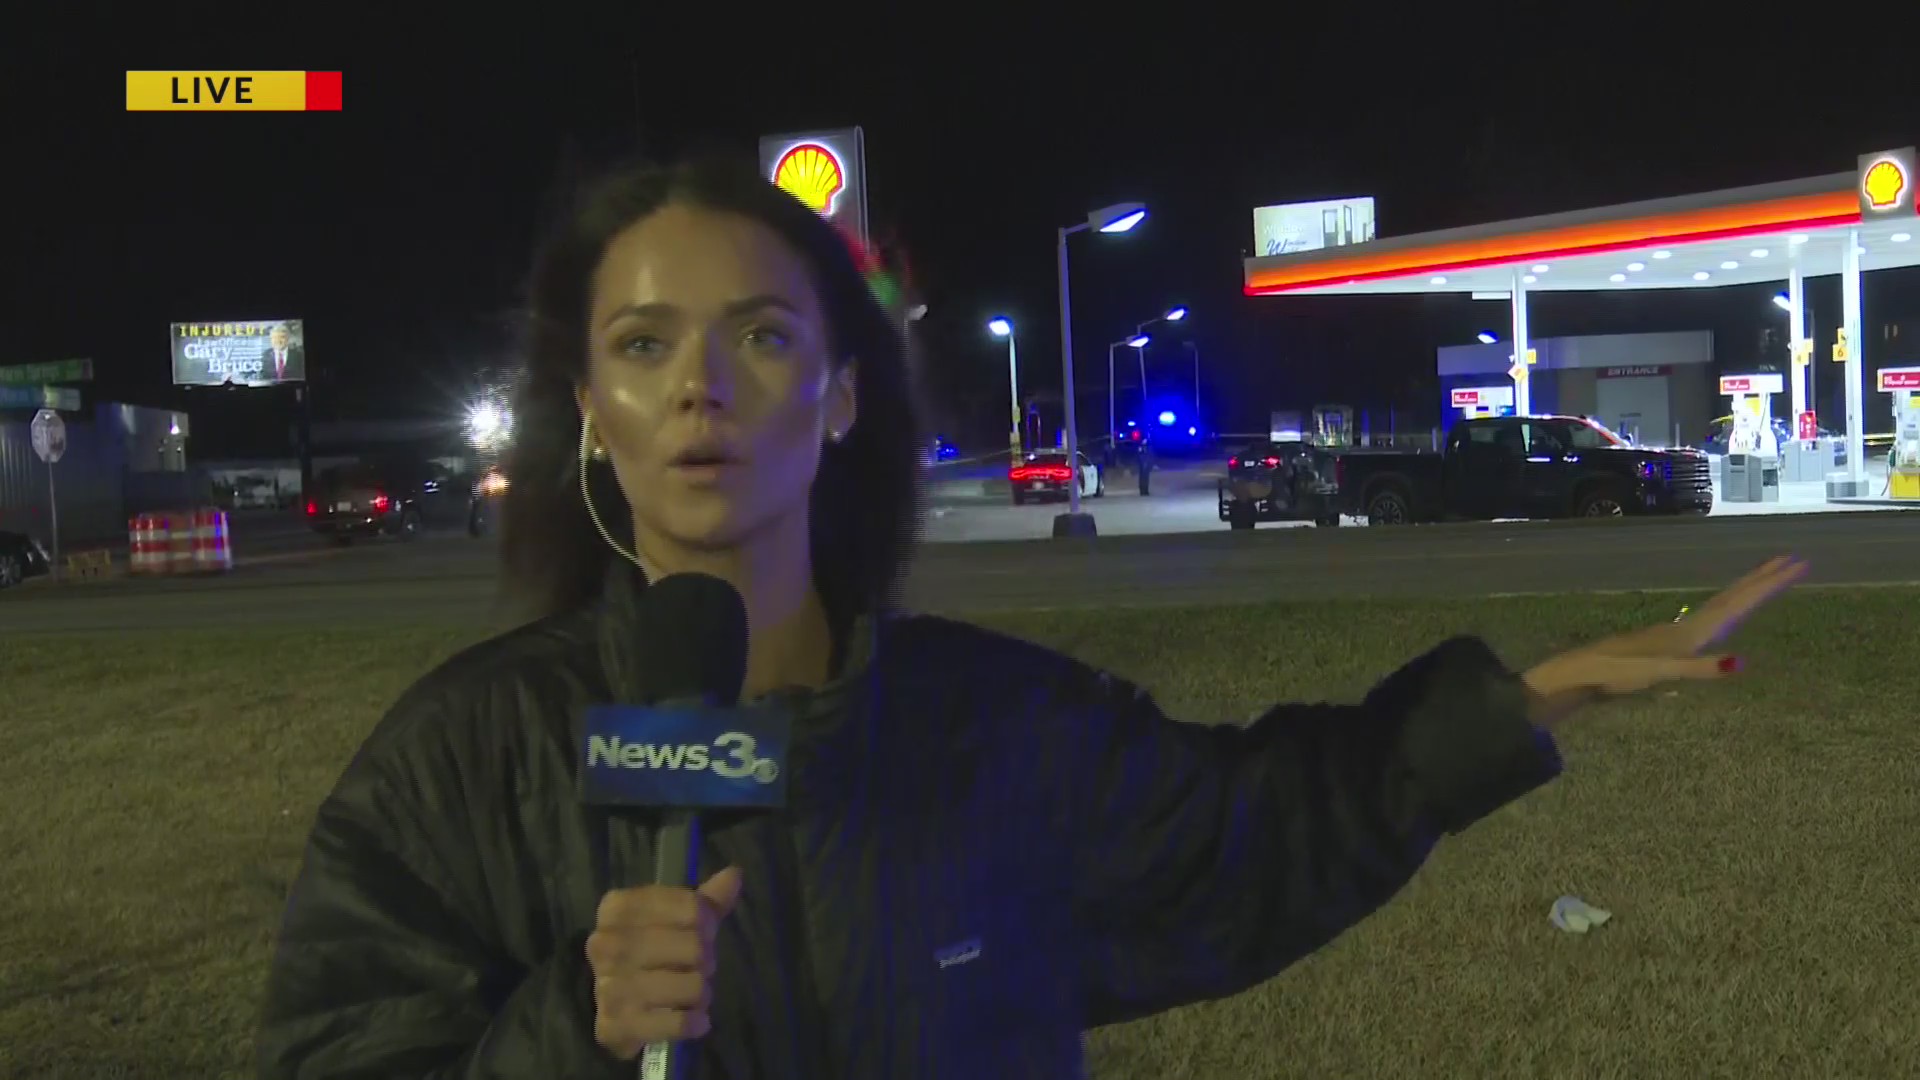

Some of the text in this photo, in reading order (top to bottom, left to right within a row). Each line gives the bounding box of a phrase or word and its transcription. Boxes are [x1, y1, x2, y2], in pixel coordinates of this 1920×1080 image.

[184, 343, 232, 360] Gary
[208, 359, 263, 373] Bruce
[1607, 366, 1659, 376] ENTRANCE
